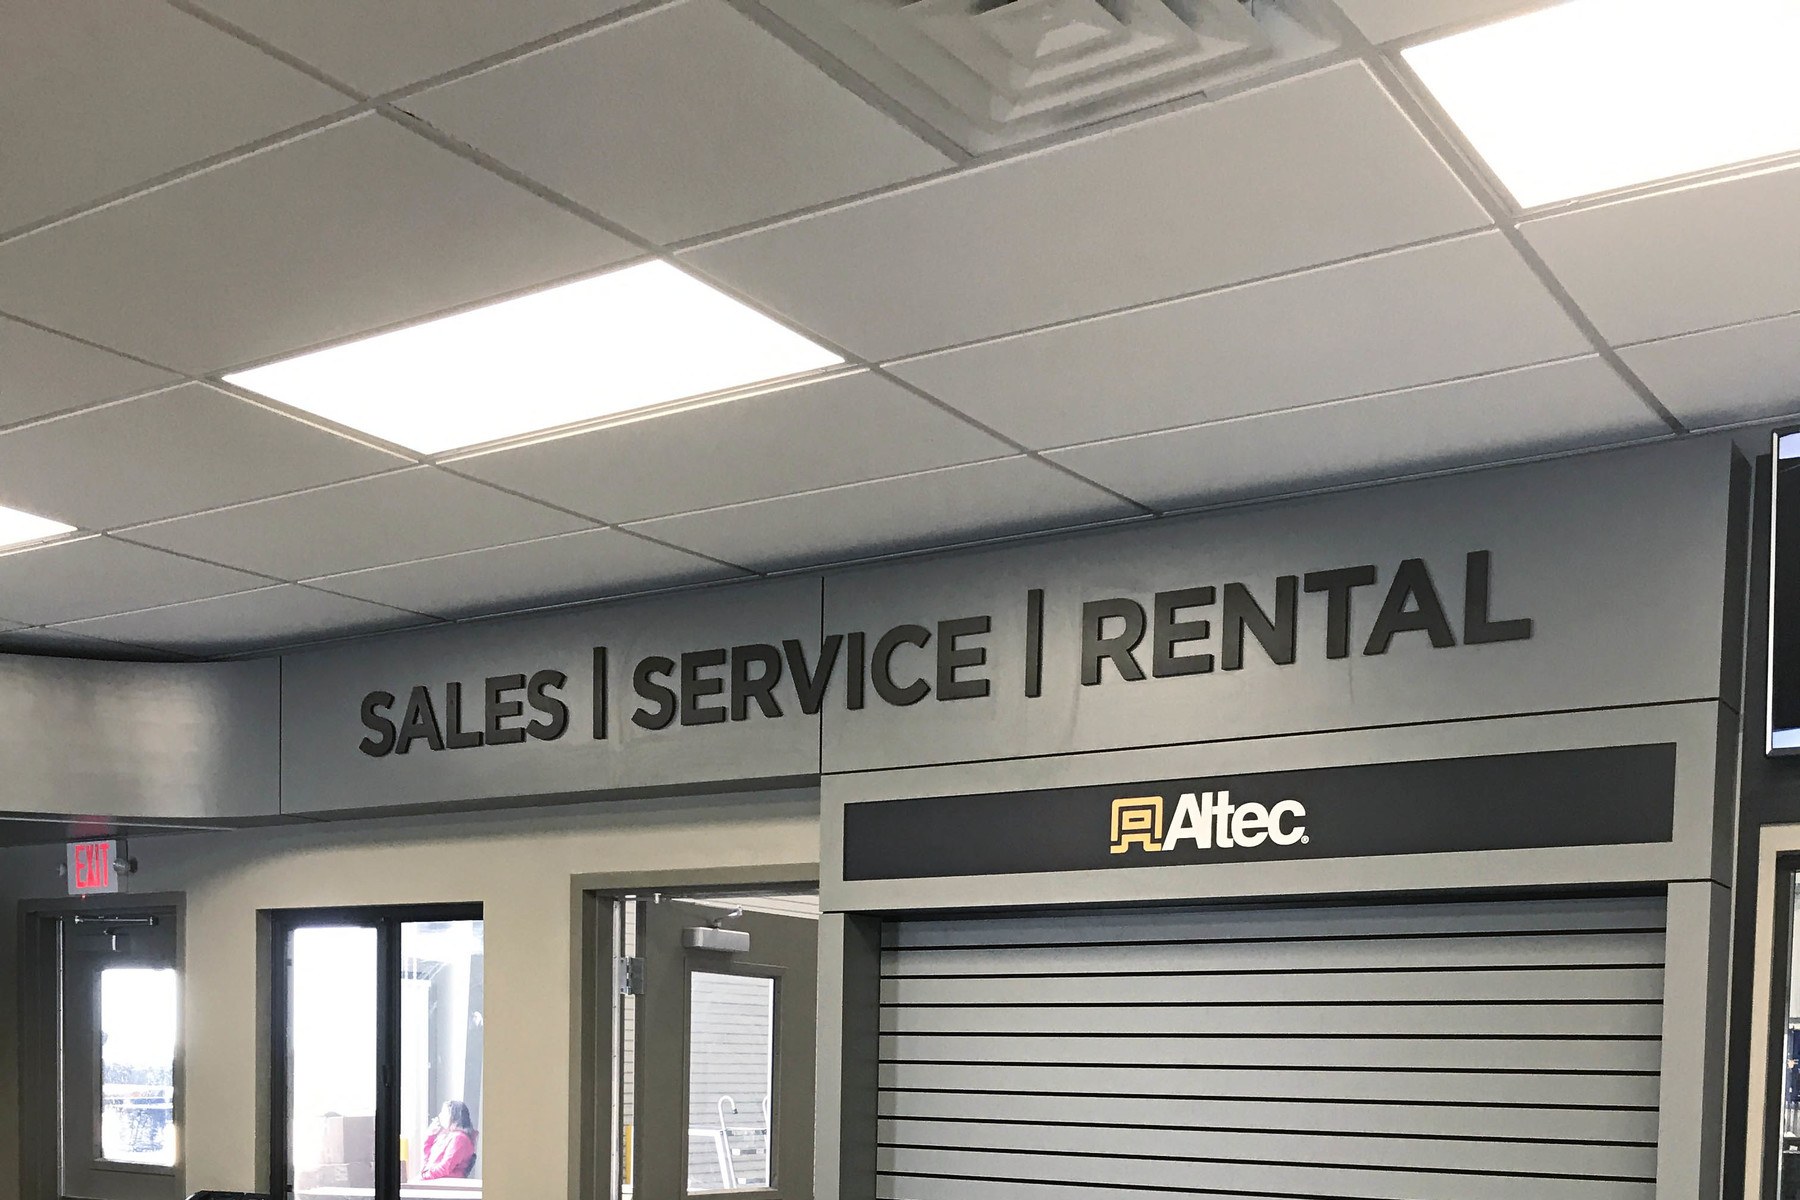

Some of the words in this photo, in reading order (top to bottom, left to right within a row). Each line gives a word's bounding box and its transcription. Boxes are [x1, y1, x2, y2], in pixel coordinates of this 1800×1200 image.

[359, 668, 569, 758] SALES
[631, 615, 991, 731] SERVICE
[1081, 550, 1533, 686] RENTAL
[1162, 790, 1307, 851] Altec
[75, 843, 110, 888] EXIT
